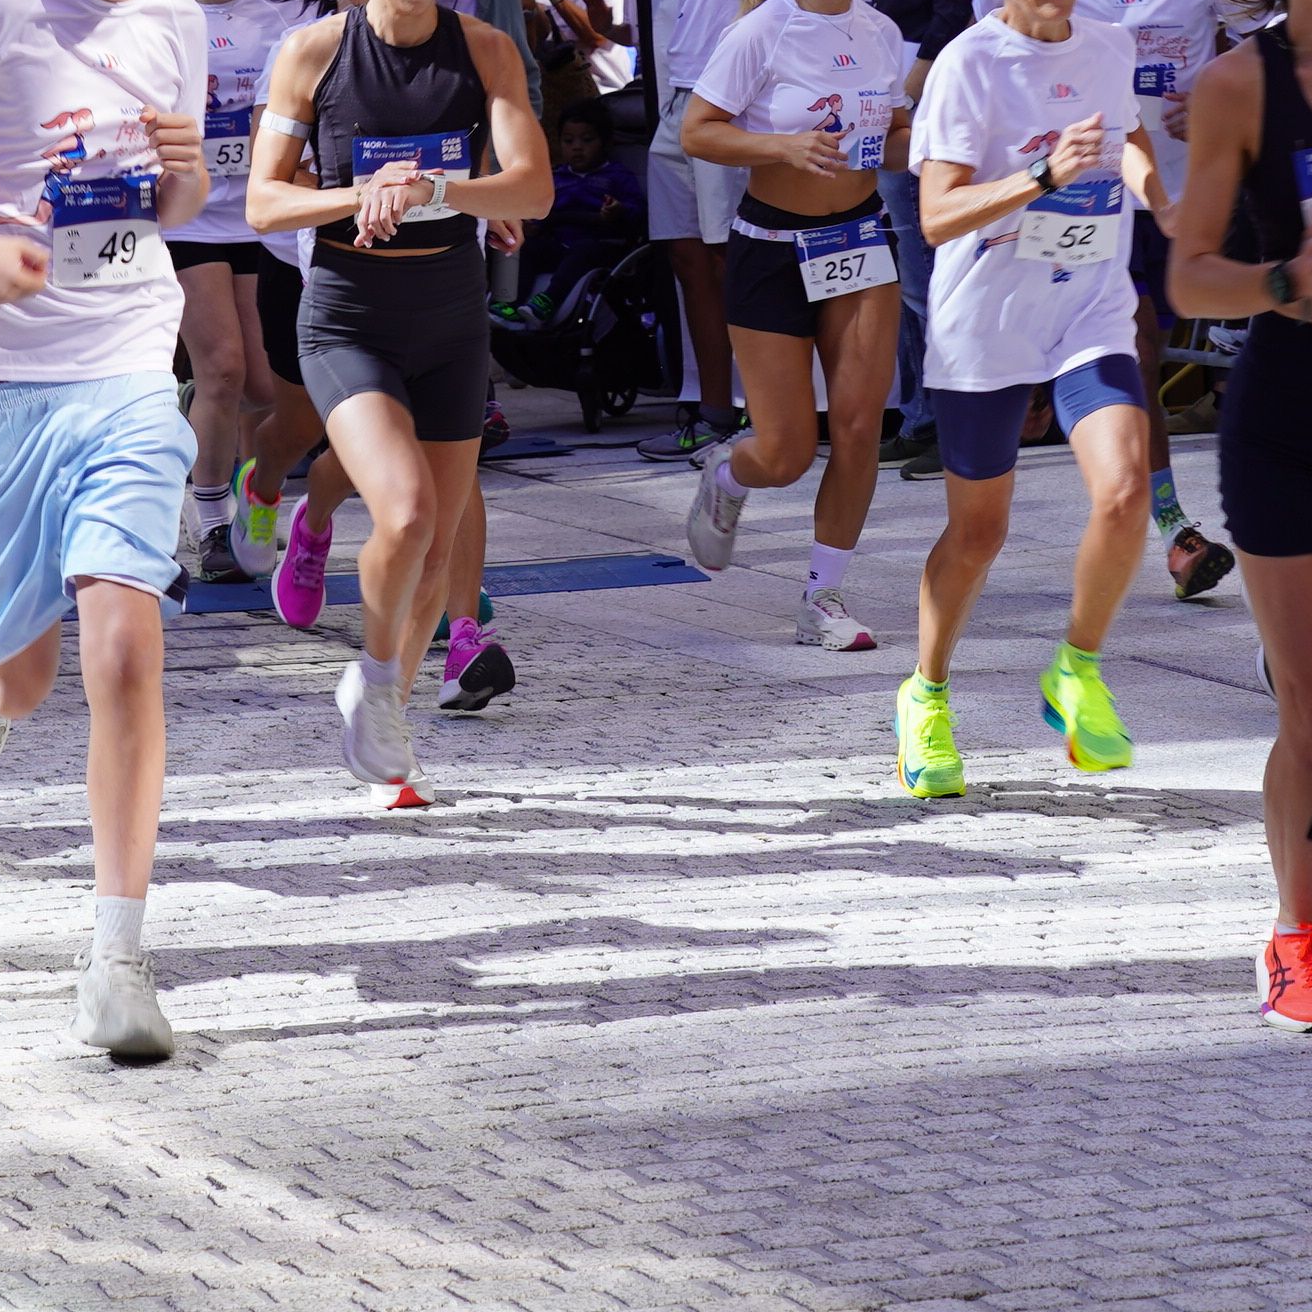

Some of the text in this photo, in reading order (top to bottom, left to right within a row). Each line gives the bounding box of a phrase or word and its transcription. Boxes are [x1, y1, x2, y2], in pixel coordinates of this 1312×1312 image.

[215, 142, 245, 165] 53
[362, 140, 387, 149] MORA
[97, 229, 137, 265] 49
[1055, 223, 1098, 249] 52
[824, 252, 867, 282] 257
